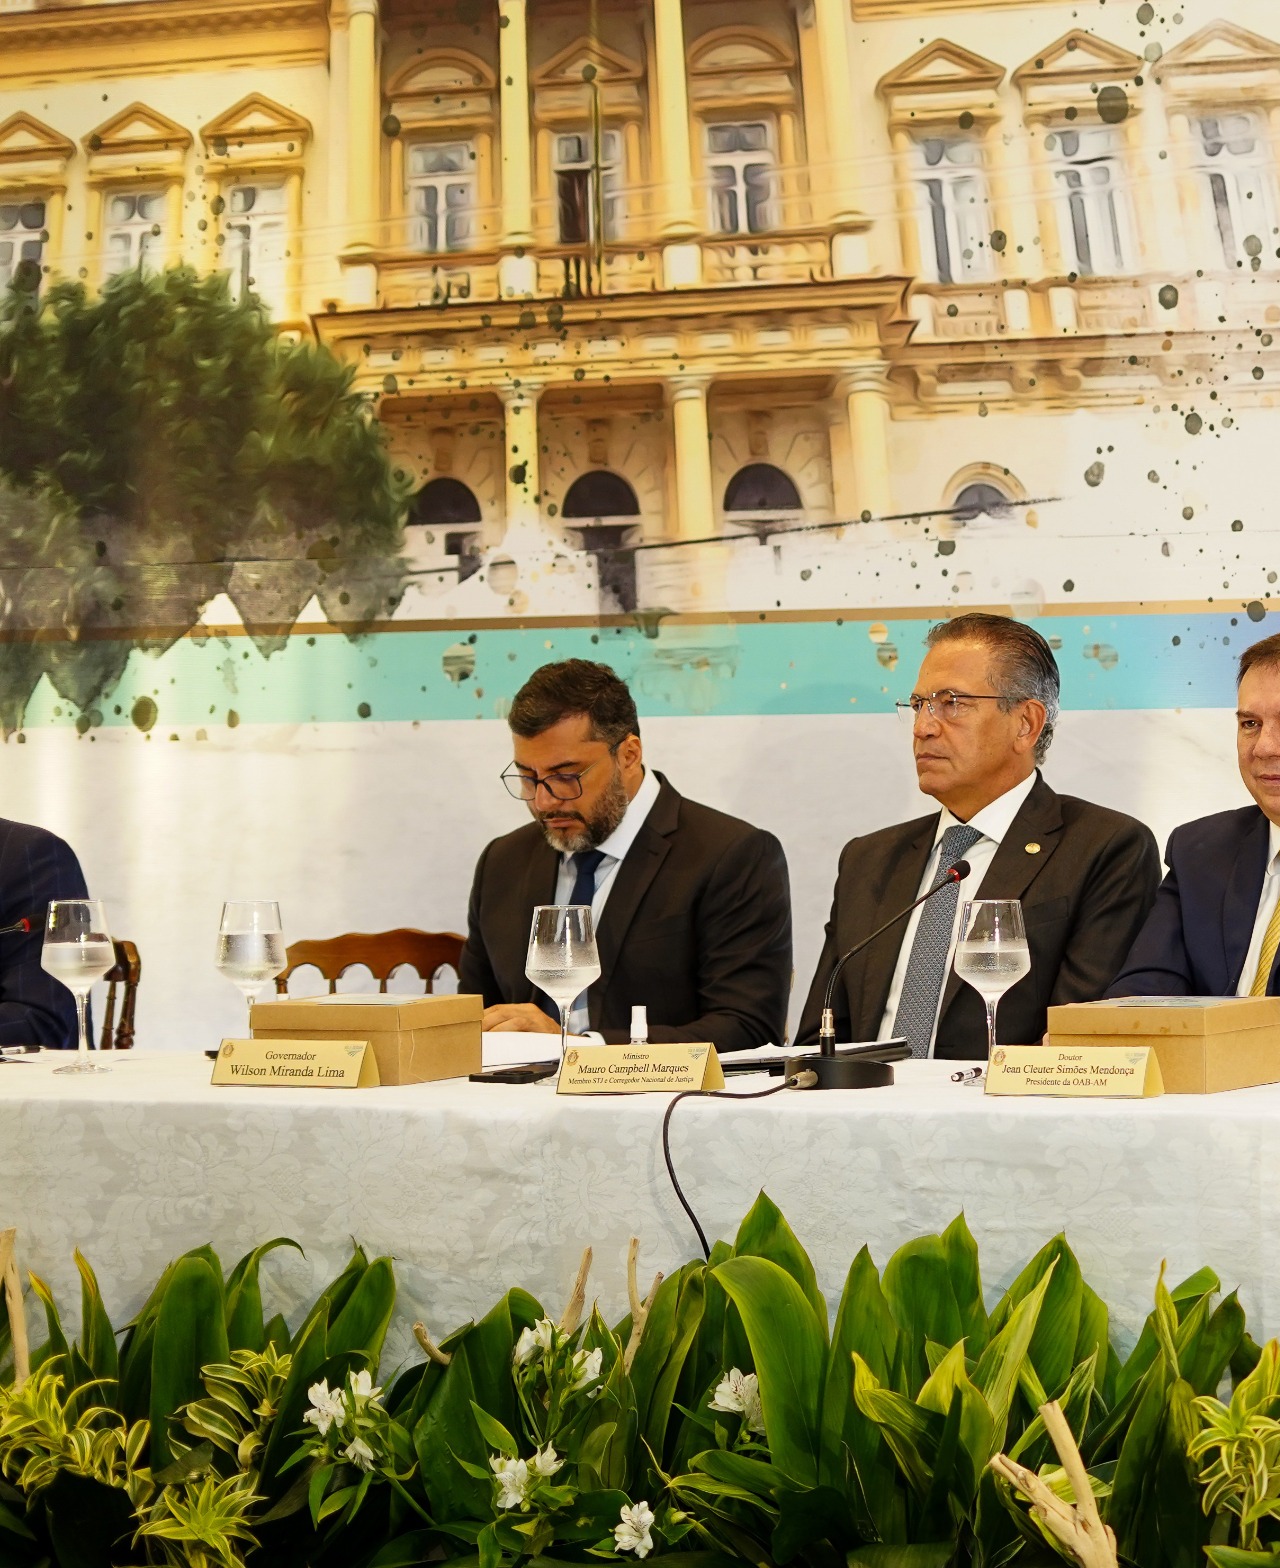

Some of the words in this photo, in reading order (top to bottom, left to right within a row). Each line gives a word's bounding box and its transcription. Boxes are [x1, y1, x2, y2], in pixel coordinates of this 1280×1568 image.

[265, 1051, 317, 1060] Governador
[1058, 1053, 1083, 1061] Doutor
[230, 1065, 266, 1076] Wilson
[269, 1065, 313, 1077] Miranda
[317, 1067, 345, 1077] Lima
[578, 1065, 606, 1074] Mauro
[608, 1063, 649, 1075] Campbell
[651, 1063, 689, 1075] Marques
[1001, 1065, 1021, 1074] Jean
[1023, 1064, 1054, 1074] Cleuter
[1056, 1064, 1087, 1074] Simões
[1089, 1066, 1134, 1076] Mendonça
[609, 1077, 640, 1085] Corregedor
[1025, 1078, 1061, 1086] Presidente
[1062, 1078, 1071, 1086] da
